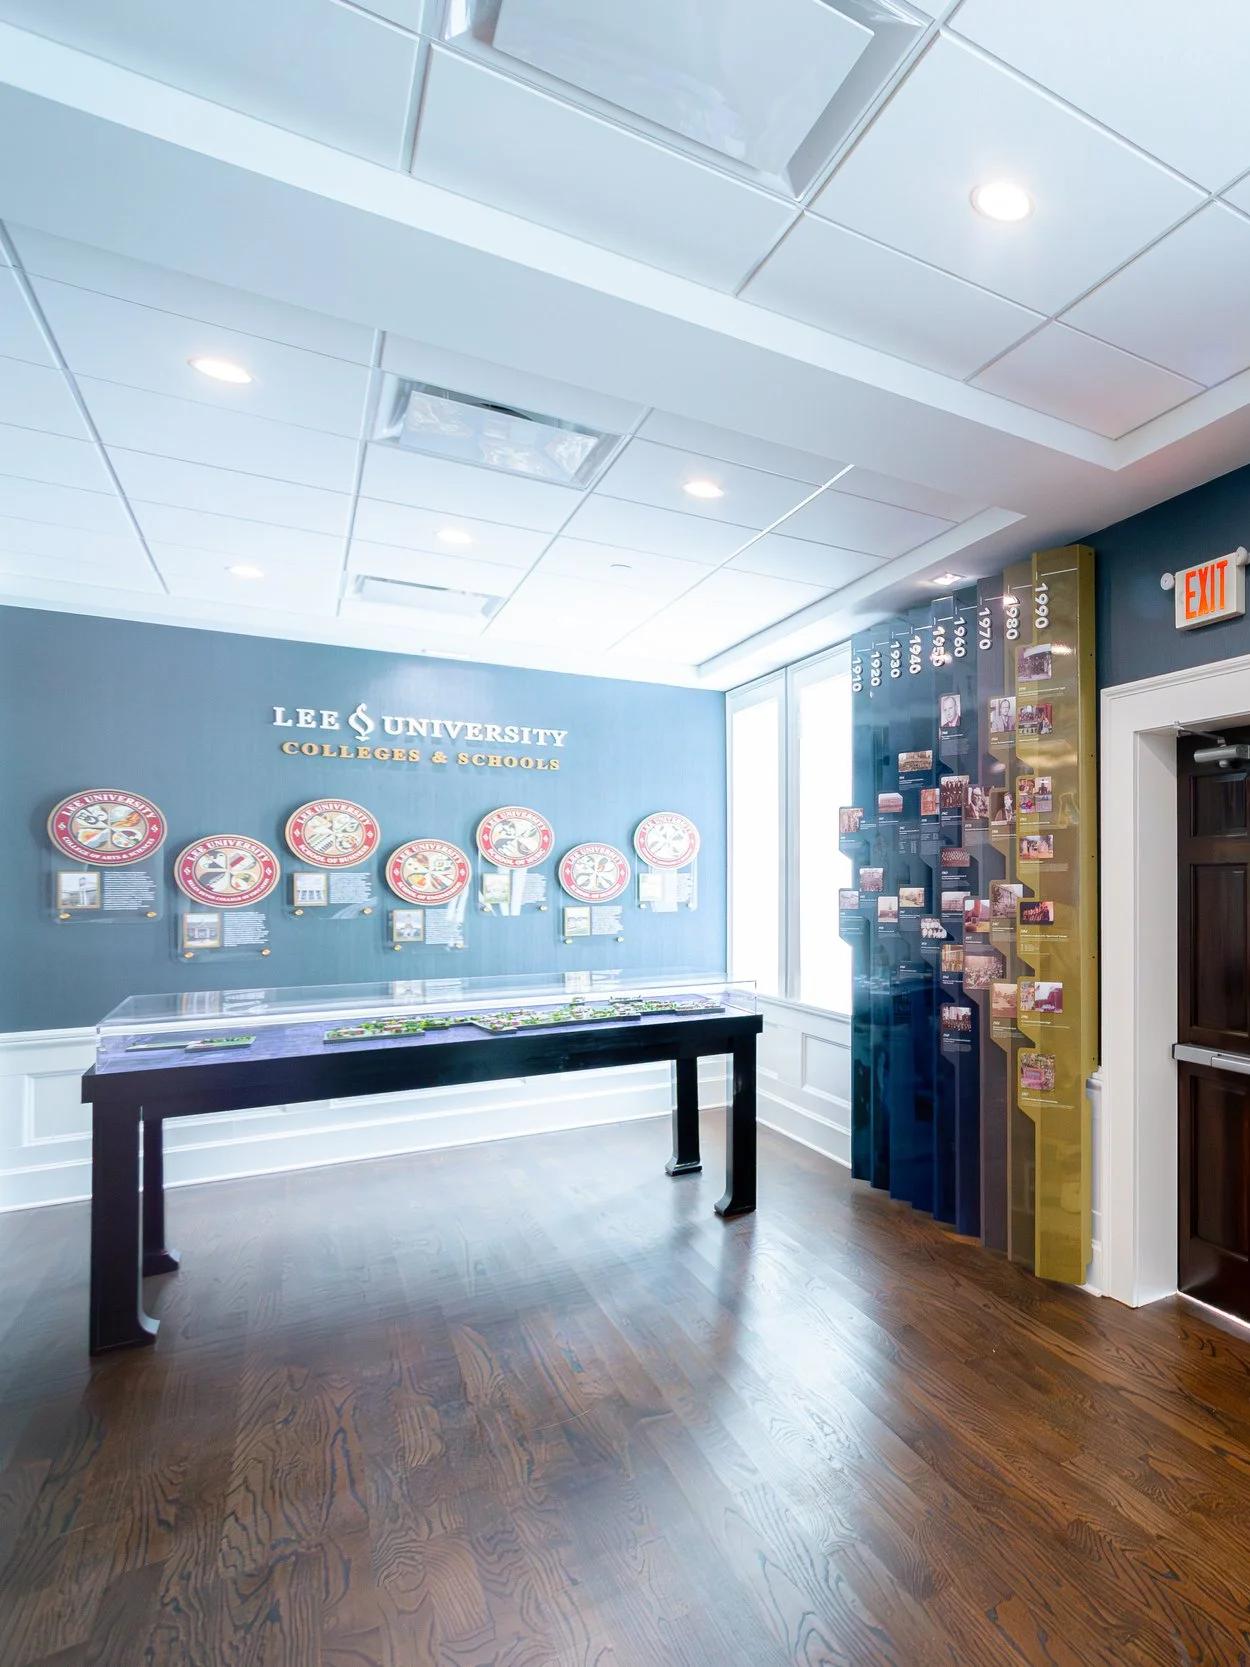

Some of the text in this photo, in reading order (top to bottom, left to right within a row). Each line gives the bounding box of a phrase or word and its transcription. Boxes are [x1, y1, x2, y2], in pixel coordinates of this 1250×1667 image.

[1035, 582, 1048, 628] 1990
[1185, 560, 1228, 620] EXIT
[979, 607, 991, 650] 1970
[1006, 596, 1019, 640] 1980
[909, 635, 921, 674] 1940
[932, 626, 945, 666] 1950
[954, 617, 966, 657] 1960
[852, 657, 862, 692] 1910
[871, 651, 881, 686] 1920
[891, 641, 901, 678] 1930
[272, 706, 568, 747] LEE UNIVERSITY
[281, 741, 560, 770] COLLEGES & SCHOOLS
[62, 793, 157, 819] LEE UNIVERSITY
[296, 803, 371, 826] LEE UNIVERSITY
[485, 811, 547, 831] LEE UNIVERSITY
[62, 836, 89, 853] COLLEGE
[187, 839, 271, 862] LEE UNIVERSITY
[299, 844, 327, 862] SCHOOL
[396, 843, 463, 864] LEE UNIVERSITY
[579, 846, 624, 865] UNIVERSITY
